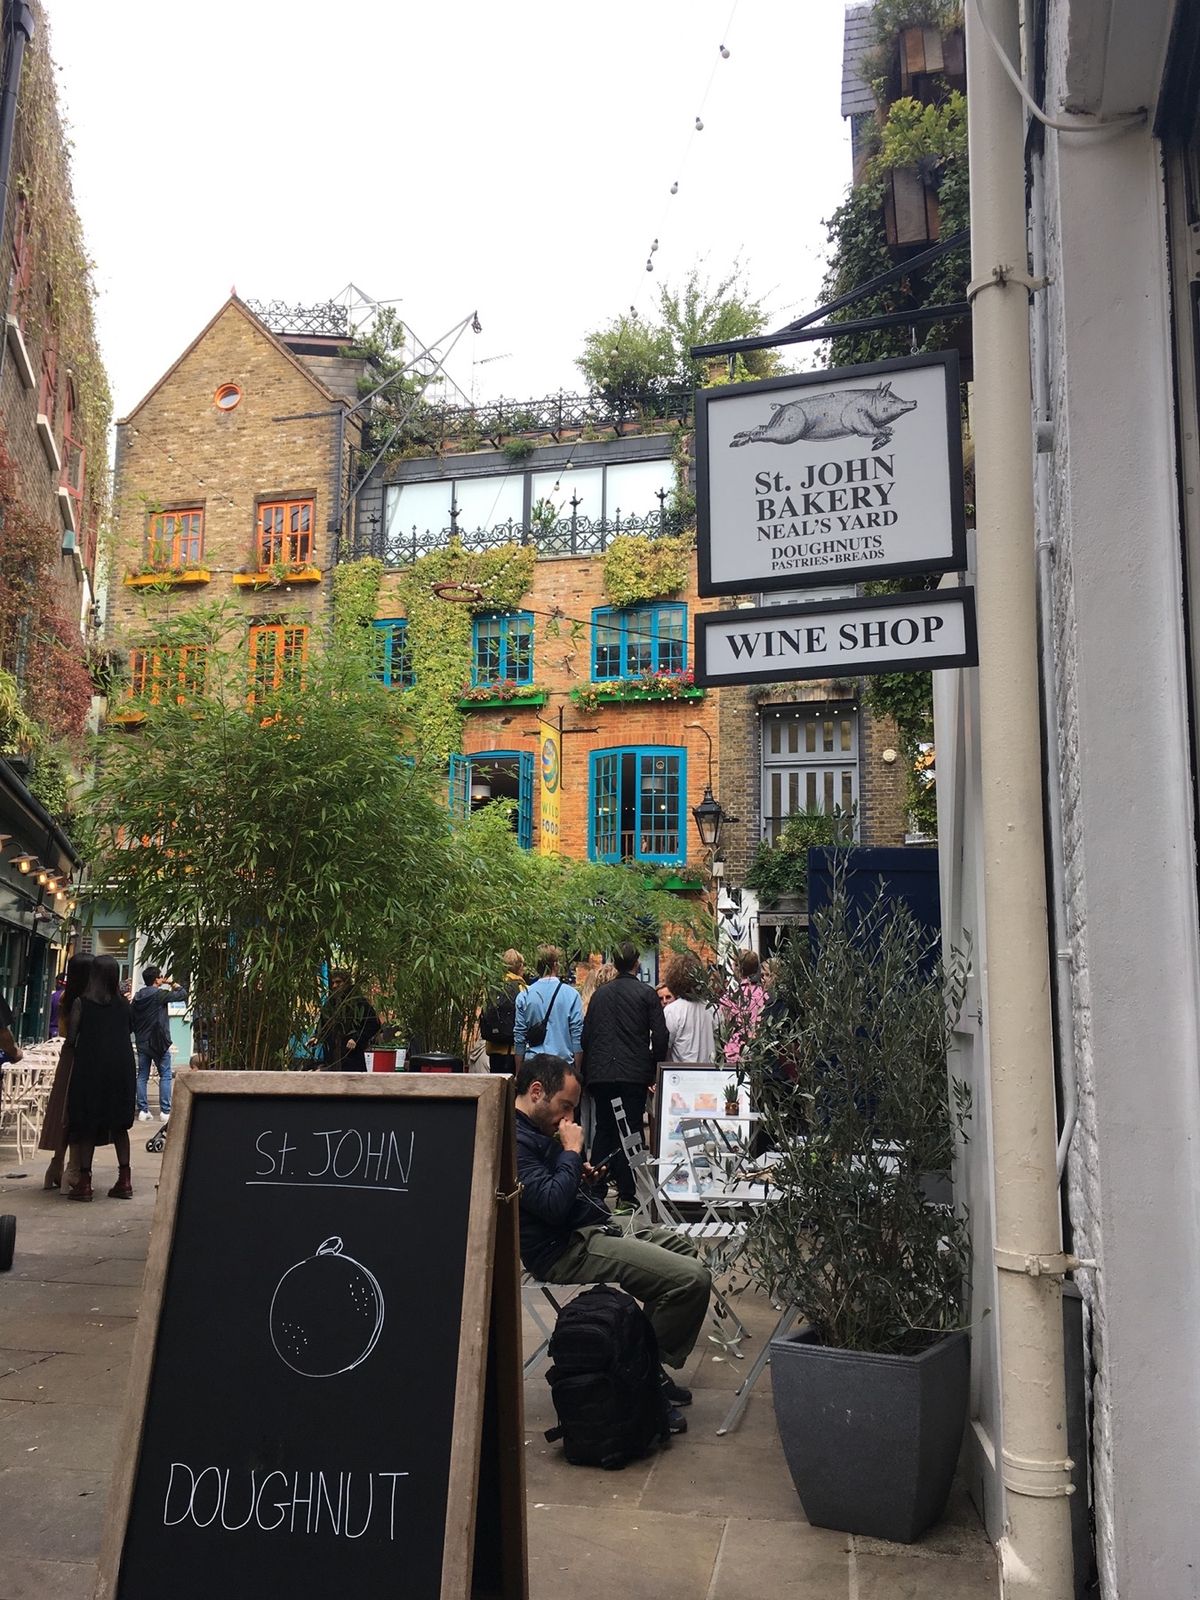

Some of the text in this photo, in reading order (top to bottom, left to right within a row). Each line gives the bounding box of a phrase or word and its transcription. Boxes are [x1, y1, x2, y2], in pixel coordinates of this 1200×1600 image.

[755, 454, 896, 495] St. JOHN
[756, 482, 896, 521] BAKERY
[757, 510, 898, 541] NEAL'S YARD
[772, 535, 882, 560] DOUGHNUTS
[725, 615, 944, 660] WINE SHOP
[308, 1129, 415, 1183] JOHN
[163, 1463, 409, 1540] DOUGHNUT
